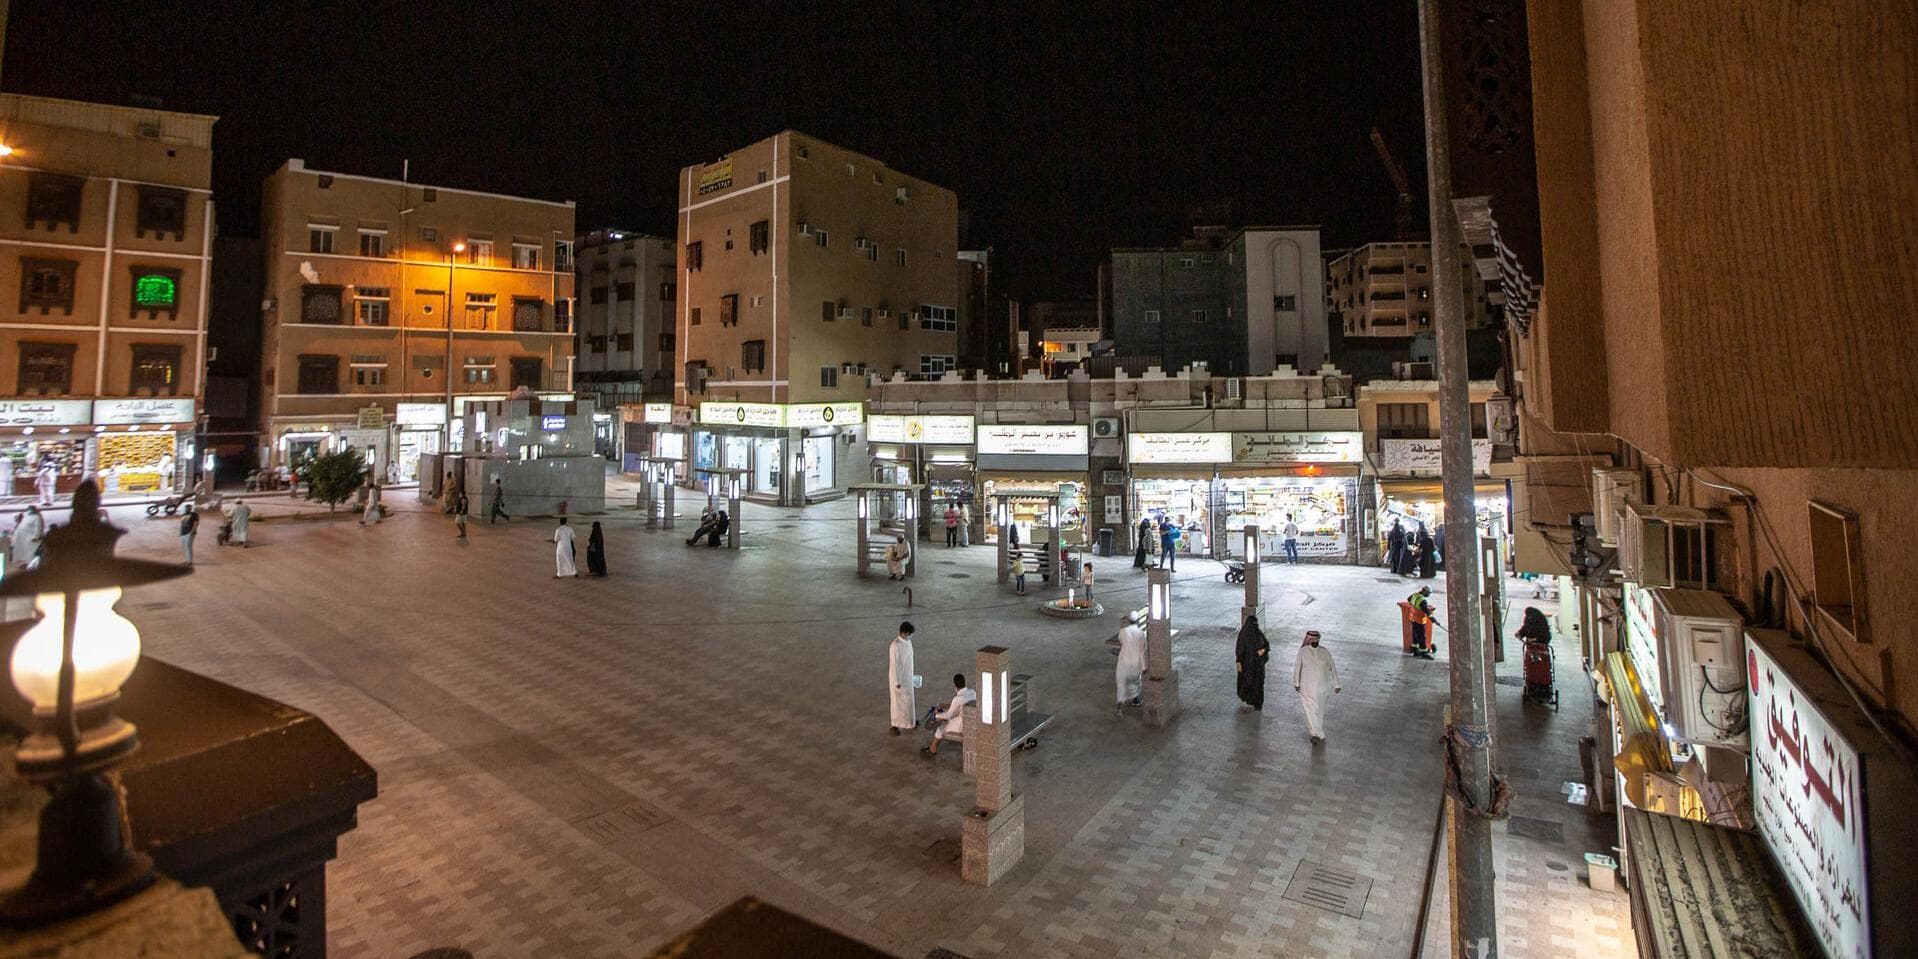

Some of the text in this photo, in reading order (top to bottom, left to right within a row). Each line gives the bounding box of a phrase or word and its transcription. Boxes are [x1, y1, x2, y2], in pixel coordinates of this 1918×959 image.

[18, 403, 55, 416] بيت
[1303, 435, 1349, 449] مركز
[1766, 667, 1856, 843] التوفيق
